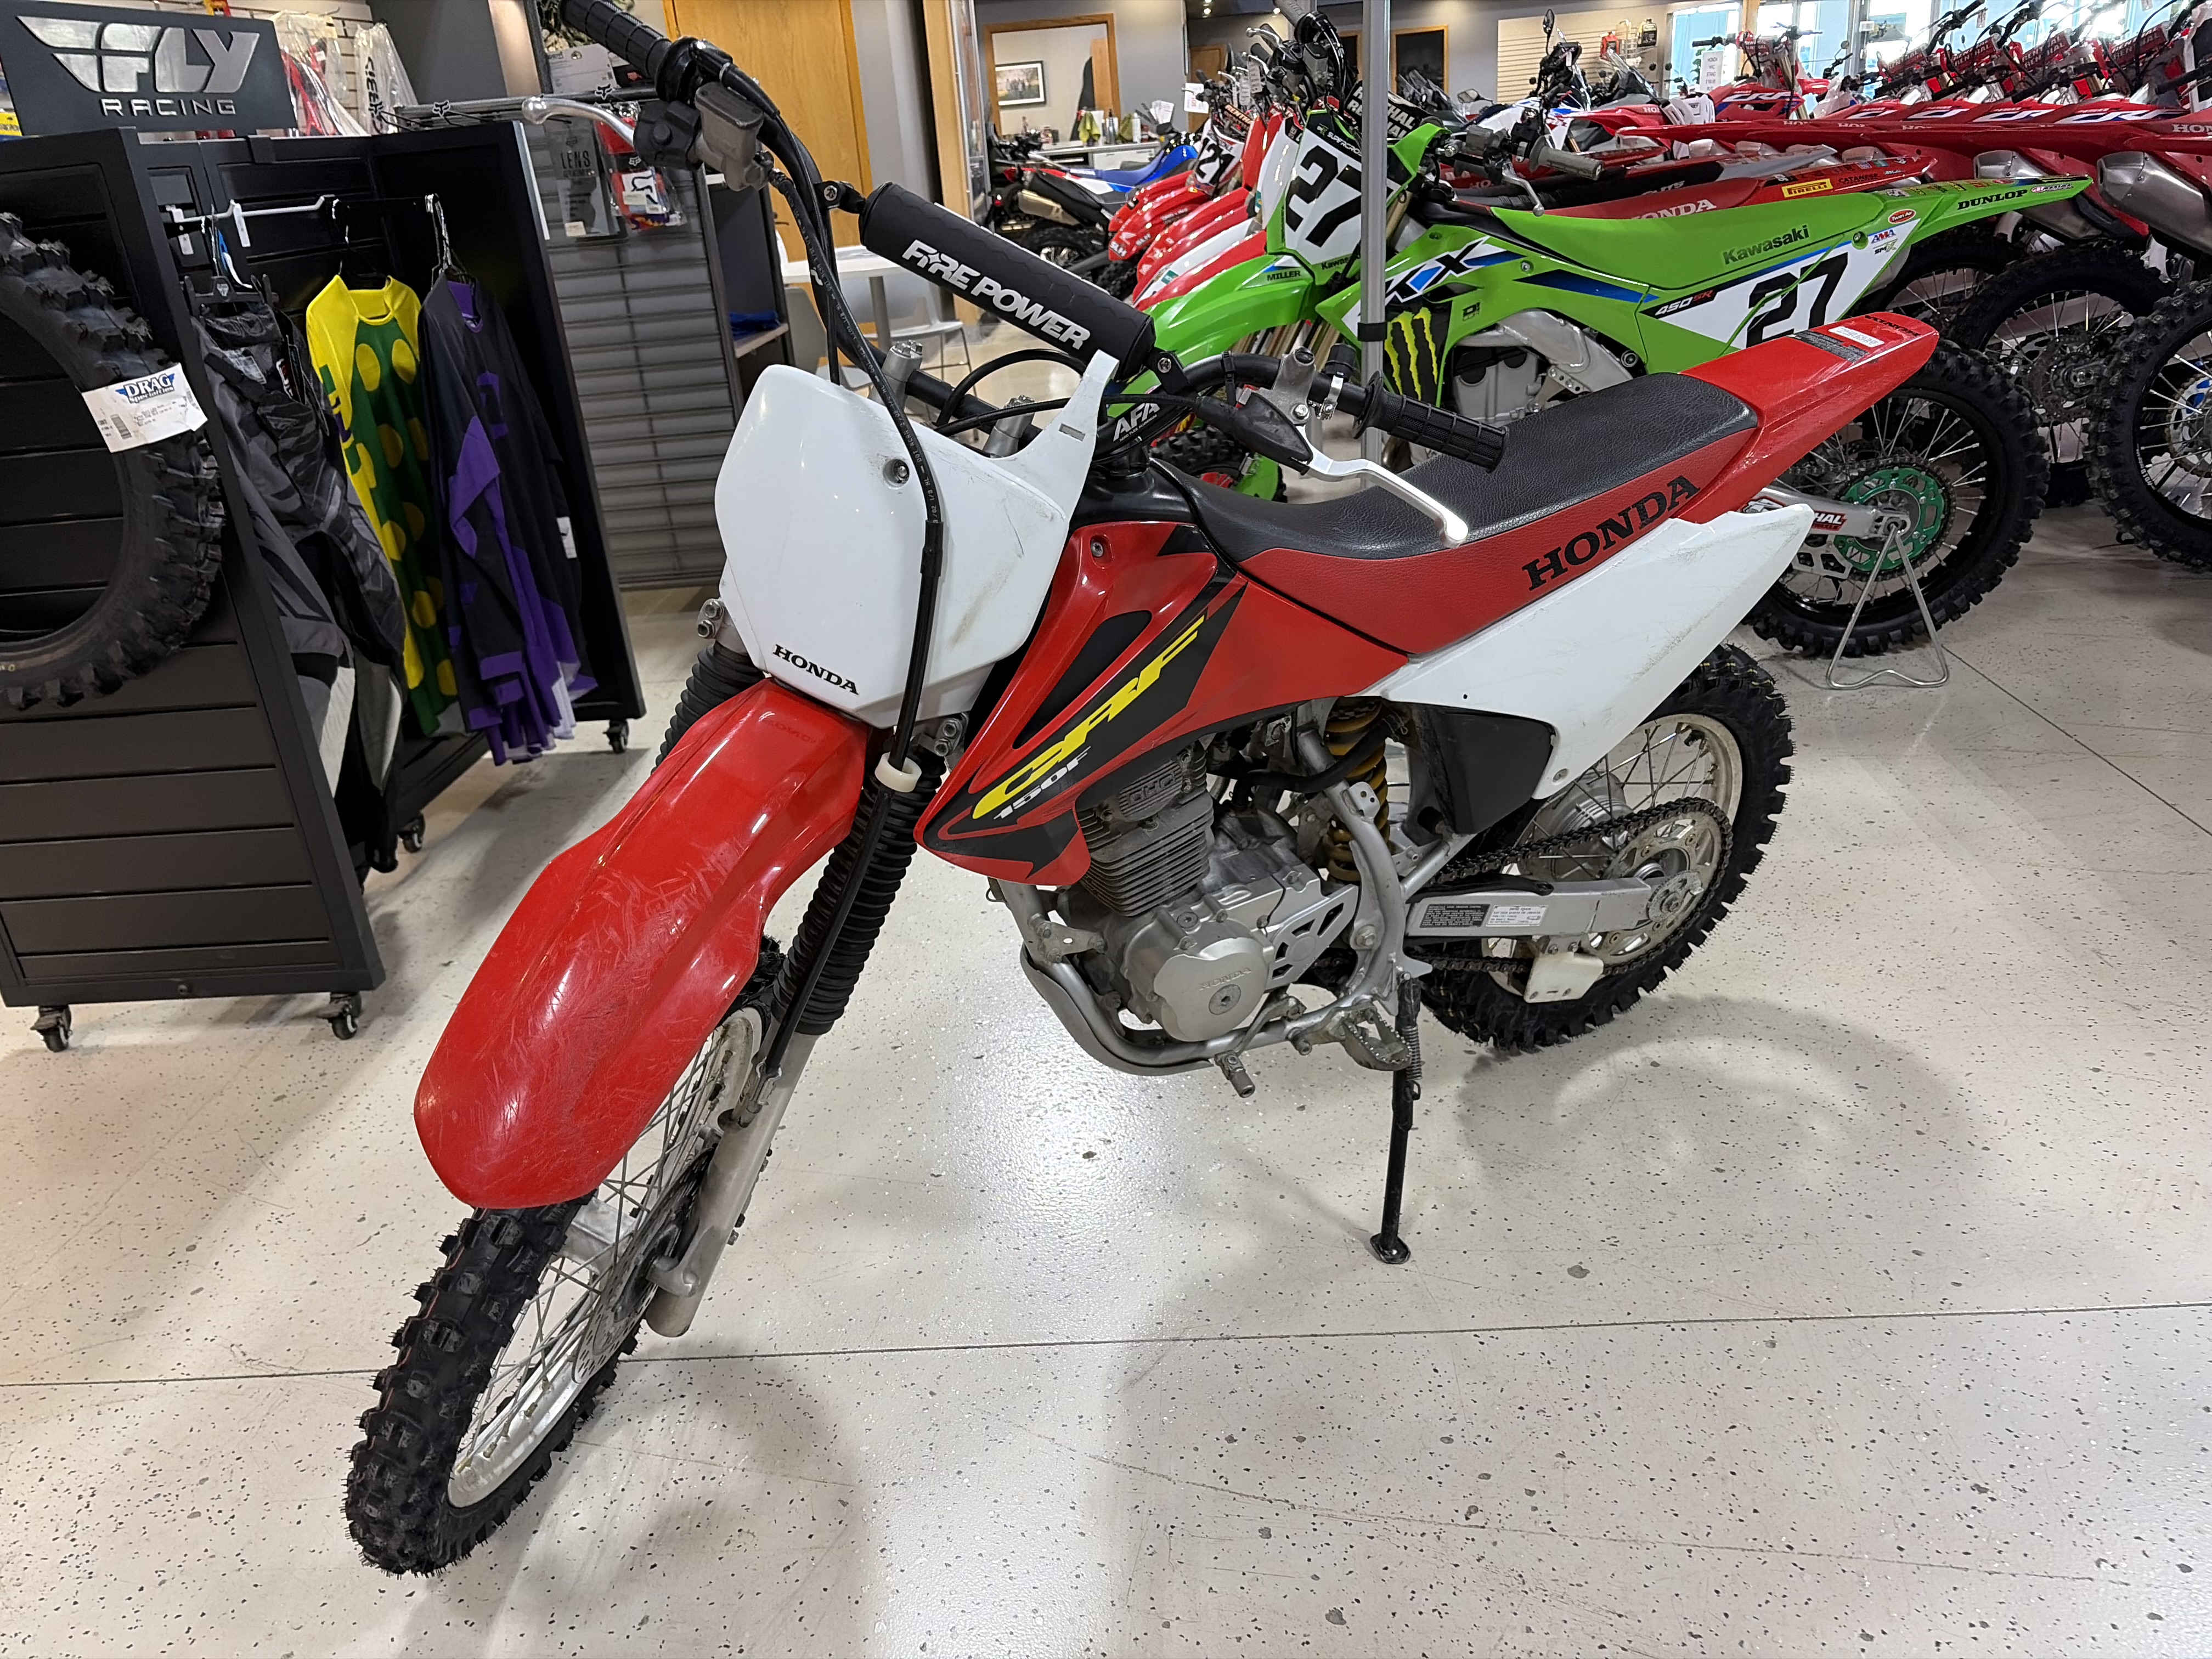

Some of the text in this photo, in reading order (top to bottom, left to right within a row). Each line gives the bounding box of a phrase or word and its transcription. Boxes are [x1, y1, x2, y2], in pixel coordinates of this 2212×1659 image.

[88, 18, 260, 93] FLY
[100, 98, 236, 116] RACING
[1326, 131, 1362, 157] SUPERCRO
[561, 150, 591, 169] LENS
[1787, 182, 1827, 195] PIRELLI
[1957, 189, 2028, 210] DUNLOP
[1632, 199, 1717, 219] ONDA
[1723, 225, 1809, 264] Kawasaki
[1871, 229, 1896, 244] AMA
[1267, 270, 1301, 281] MILLER
[901, 239, 1091, 351] FIRE POWER
[1655, 290, 1714, 316] 450SR
[1747, 252, 1848, 348] 27
[123, 374, 173, 397] DRAG
[1114, 403, 1160, 442] AFA
[912, 449, 922, 462] DOT
[1521, 475, 1701, 591] HONDA
[772, 644, 859, 695] HONDA
[973, 615, 1205, 819] CRF
[994, 746, 1091, 820] 150F
[1198, 967, 1251, 991] HONDA
